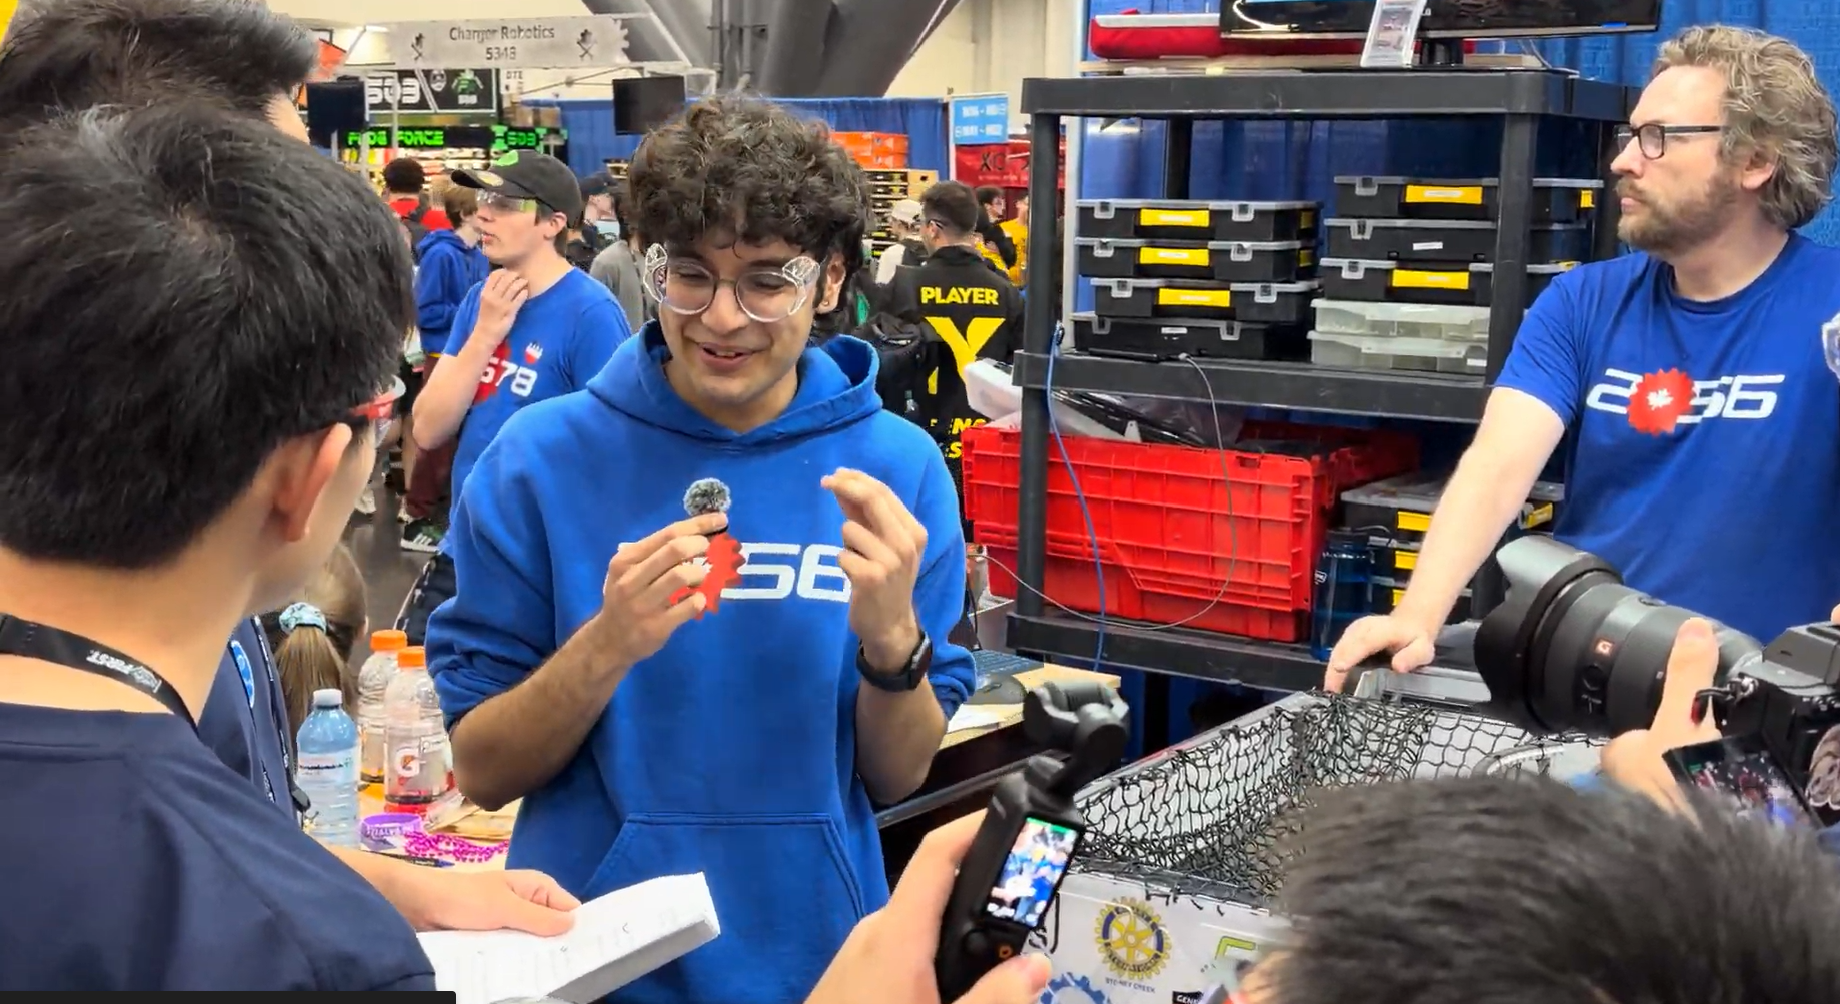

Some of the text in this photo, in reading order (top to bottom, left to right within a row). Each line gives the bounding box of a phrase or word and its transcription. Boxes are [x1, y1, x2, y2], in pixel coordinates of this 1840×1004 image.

[449, 25, 555, 43] Charger Robotics
[397, 130, 444, 146] FORCE
[920, 286, 999, 306] PLAYER
